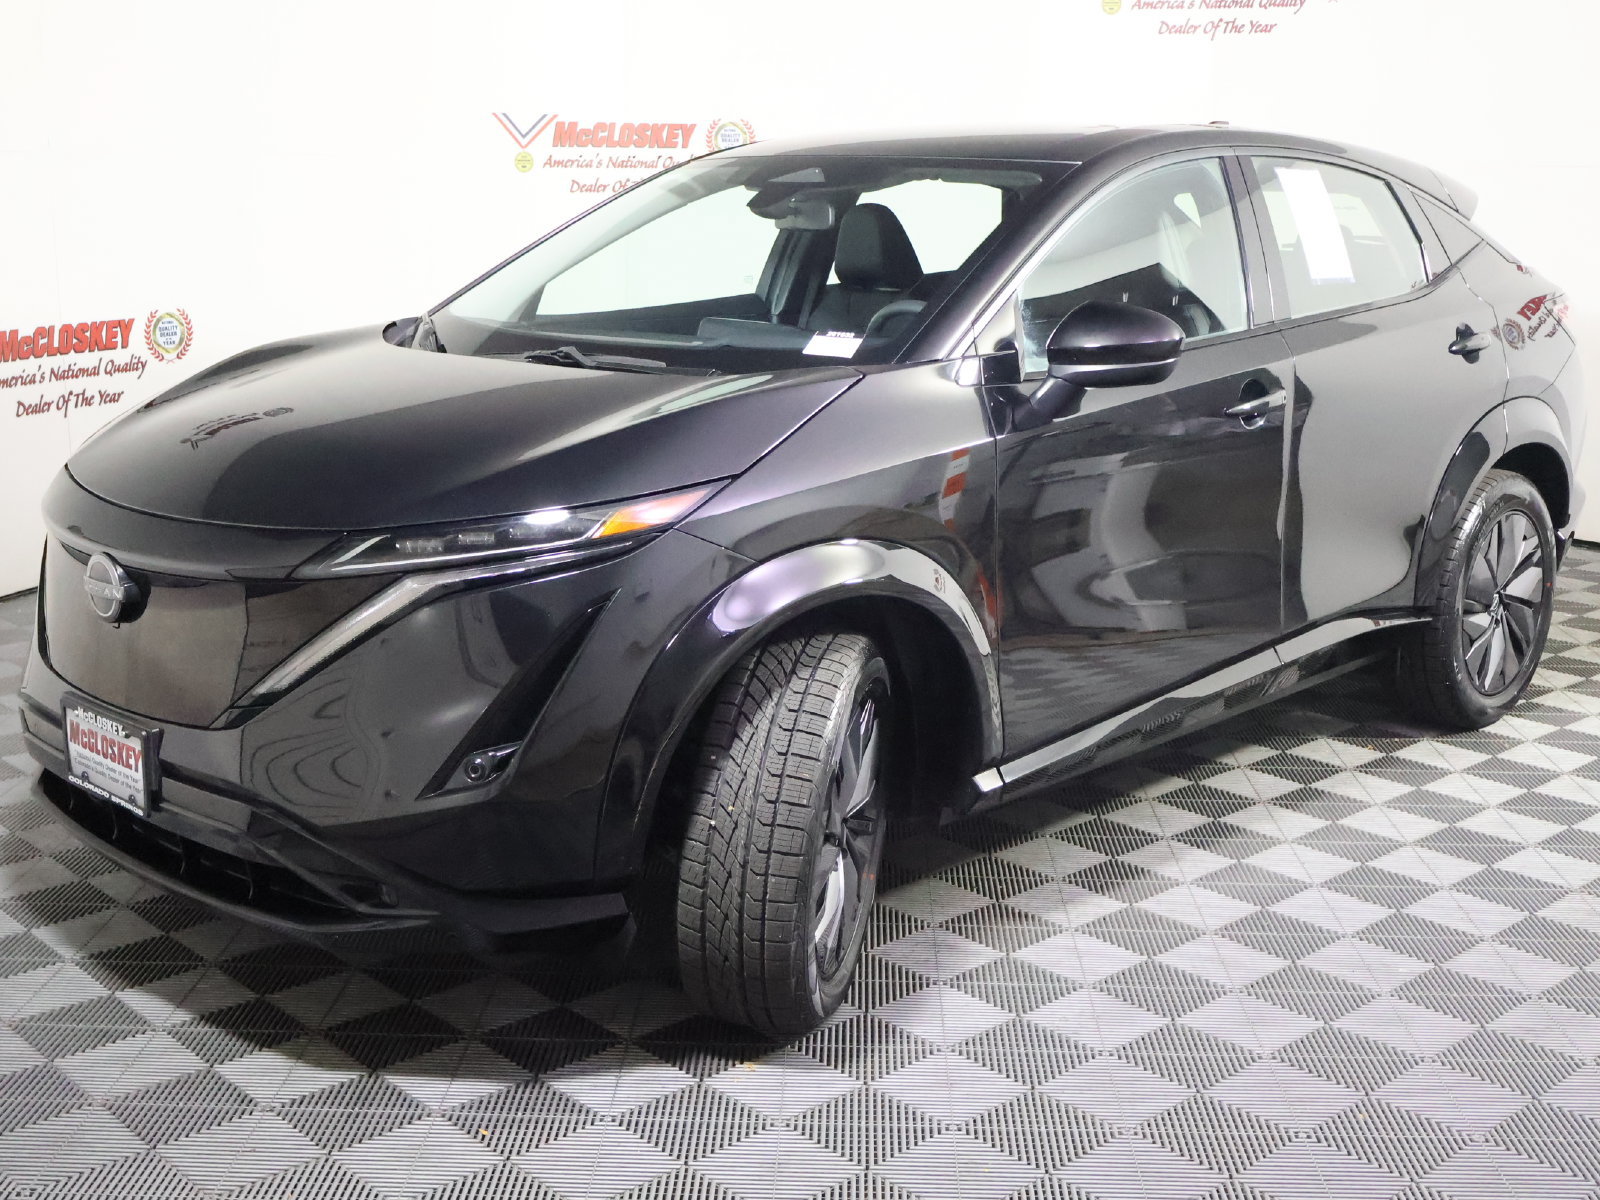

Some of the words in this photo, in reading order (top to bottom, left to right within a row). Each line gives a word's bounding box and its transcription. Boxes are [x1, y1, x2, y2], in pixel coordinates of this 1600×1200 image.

[1158, 18, 1201, 34] Dealer
[1203, 18, 1223, 41] Of
[1223, 17, 1245, 34] The
[1249, 20, 1277, 34] Year
[552, 121, 697, 149] McCLOSKEY
[543, 152, 603, 169] America's
[606, 155, 660, 169] National
[570, 178, 610, 193] Dealer
[0, 318, 135, 362] McCLOSKEY
[0, 364, 46, 389] merica's
[49, 358, 103, 382] National
[104, 354, 148, 379] Quality
[16, 394, 54, 417] Dealer
[56, 390, 73, 418] Of
[74, 388, 95, 408] The
[98, 389, 124, 406] Year
[78, 706, 123, 736] McCLOSKEY
[69, 720, 143, 773] McCLOSKEY
[69, 775, 110, 799] COLORADO
